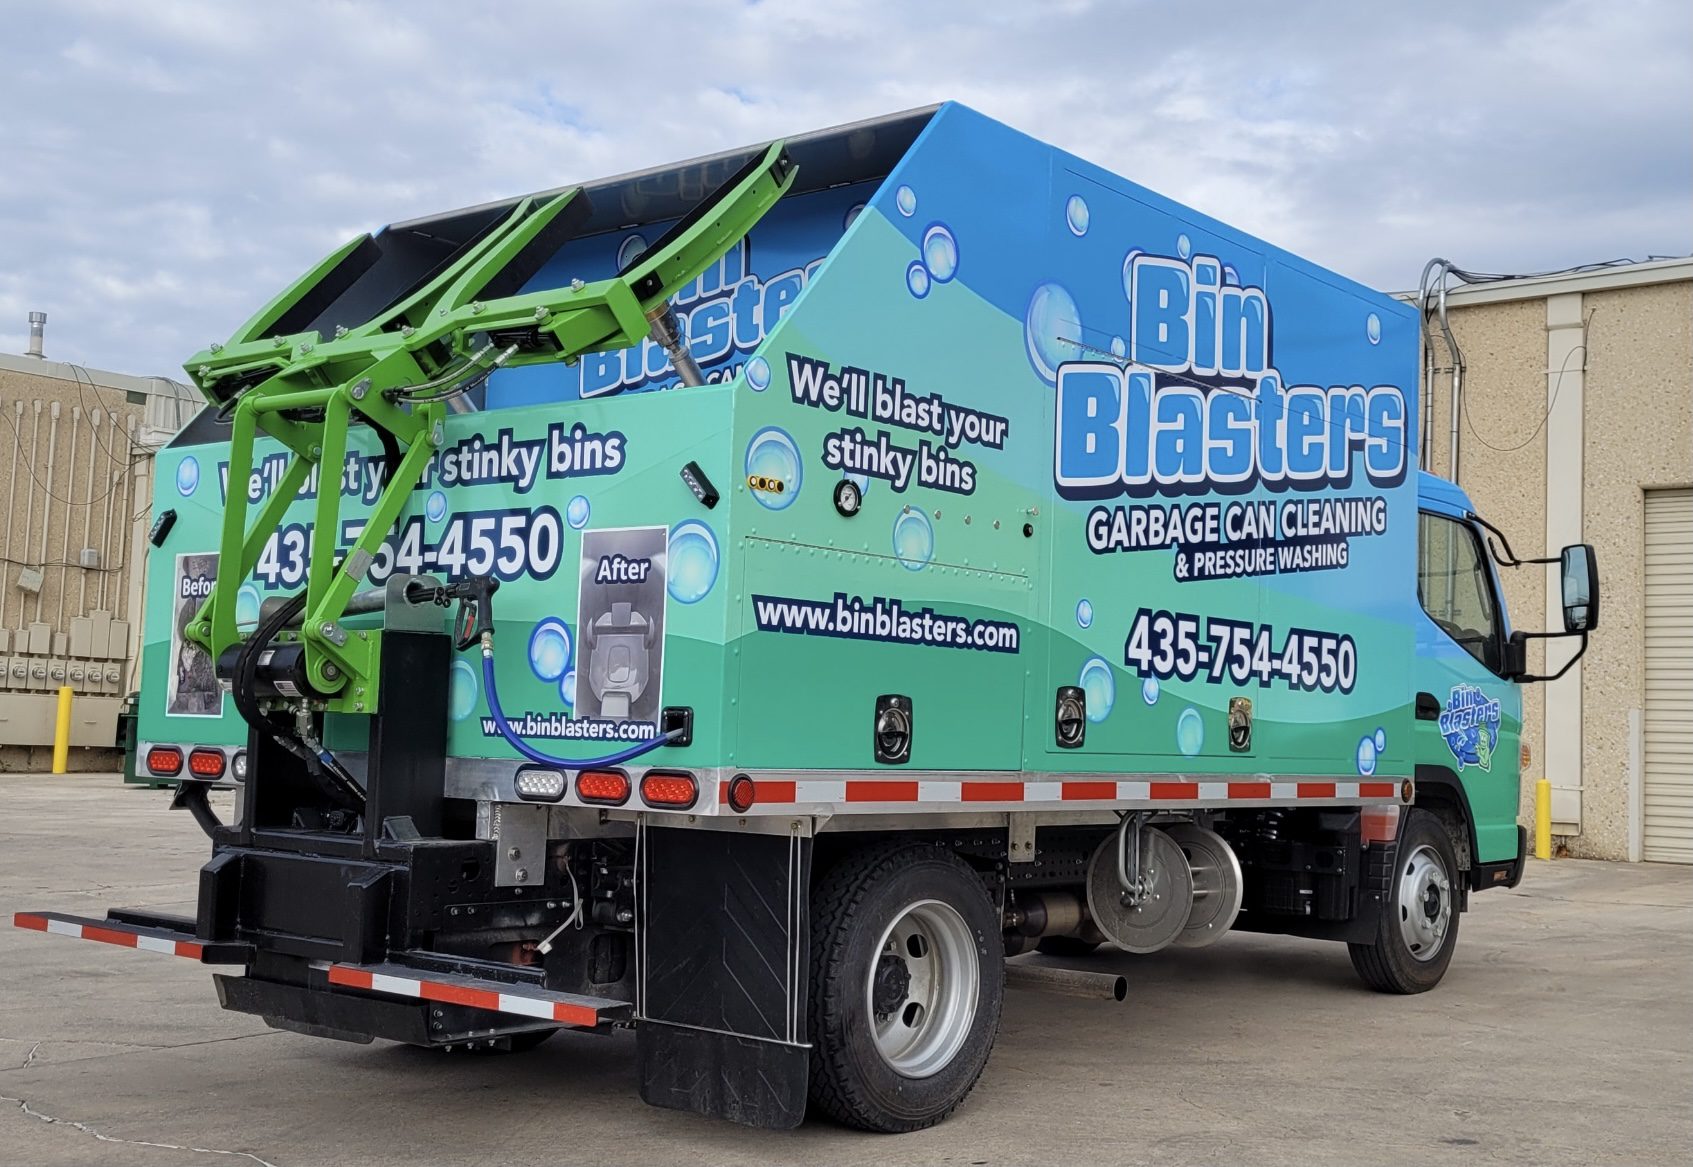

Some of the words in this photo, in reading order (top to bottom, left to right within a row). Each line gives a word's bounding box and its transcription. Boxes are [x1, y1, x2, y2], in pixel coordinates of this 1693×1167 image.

[580, 257, 827, 398] Blste
[1132, 254, 1271, 378] Bin
[790, 358, 866, 413] We'll
[875, 379, 942, 431] blast
[947, 409, 1006, 445] your
[1057, 362, 1406, 490] Blasters
[221, 458, 285, 499] e'll
[366, 455, 435, 500] yr
[443, 434, 540, 488] stinky
[550, 429, 621, 473] bins
[826, 432, 912, 488] stinky
[920, 446, 973, 491] bins
[256, 513, 559, 583] 43-54-4550
[1088, 506, 1219, 550] GARBAGE
[1225, 504, 1275, 541] CAN
[1281, 500, 1386, 537] CLEANING
[182, 576, 217, 596] Befor
[597, 557, 649, 581] After
[1175, 556, 1189, 578] &
[1193, 549, 1275, 578] PRESSURE
[1278, 542, 1348, 569] WASHING
[757, 598, 1017, 649] www.binblasters.com
[1127, 614, 1356, 690] 435-754-4550
[1439, 698, 1500, 736] Blasters
[1451, 684, 1474, 711] Bin
